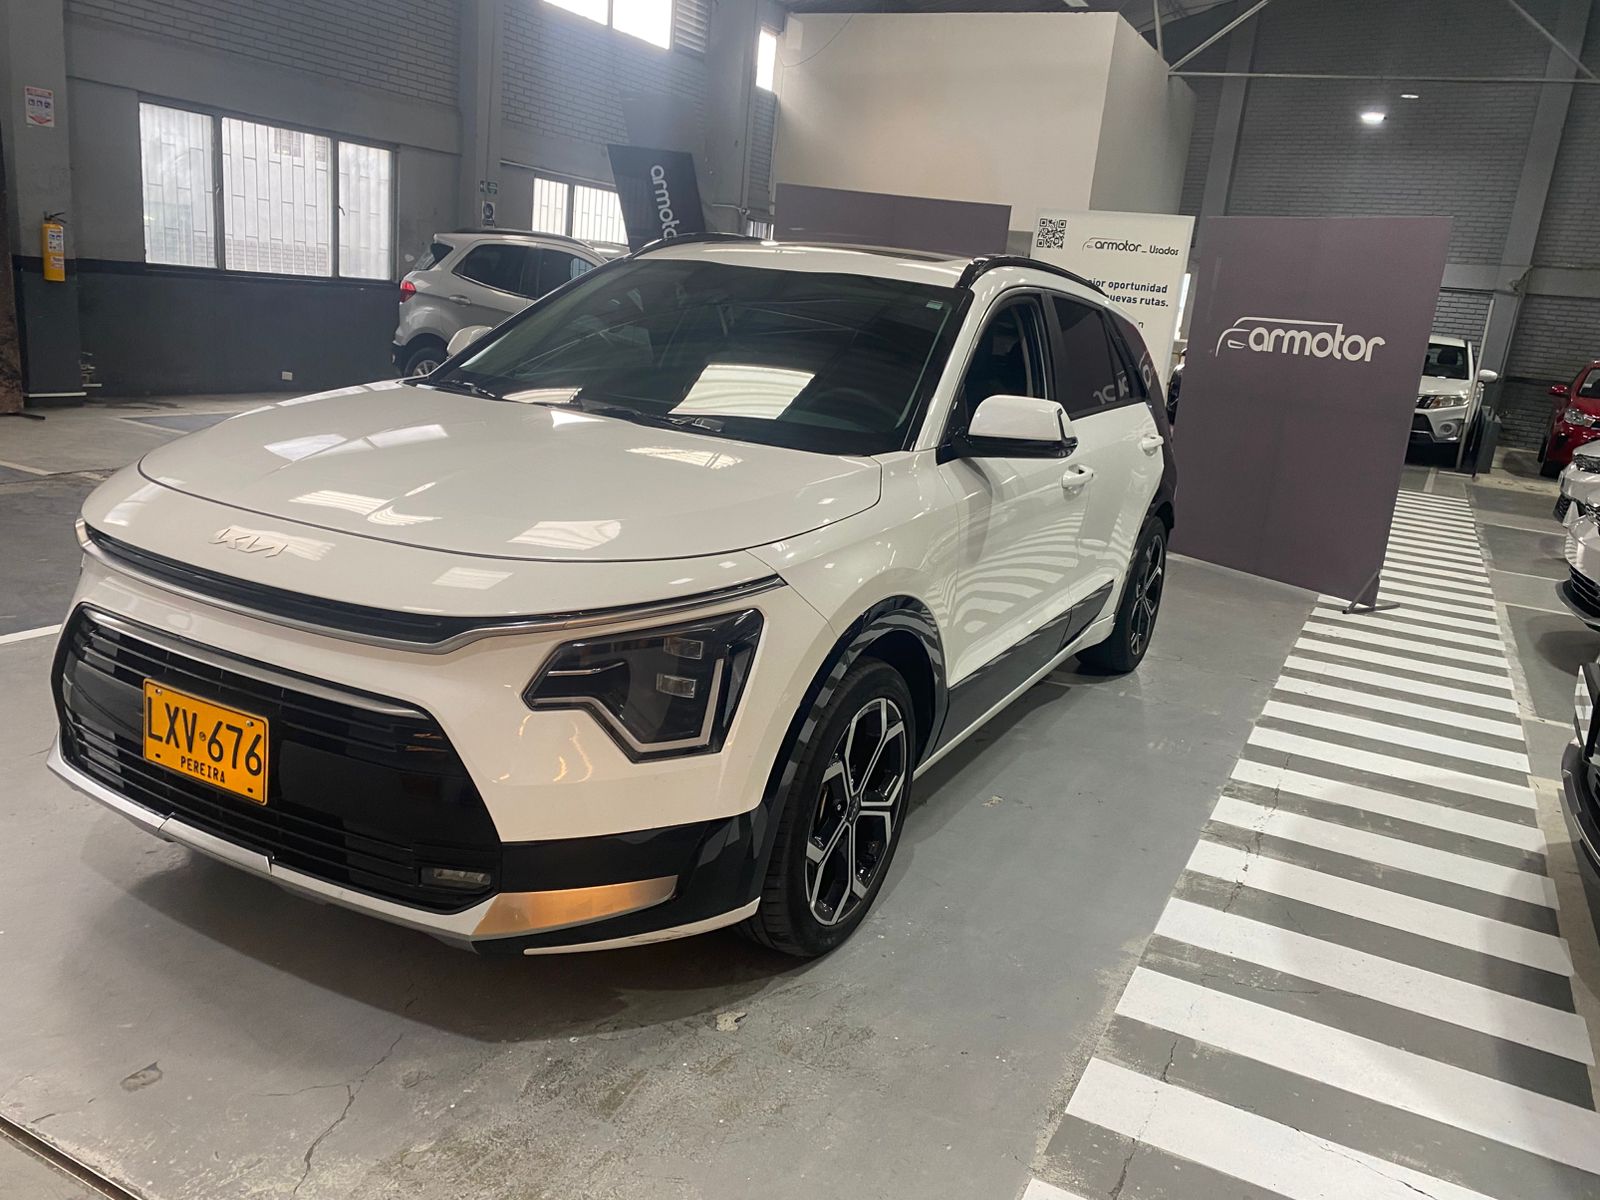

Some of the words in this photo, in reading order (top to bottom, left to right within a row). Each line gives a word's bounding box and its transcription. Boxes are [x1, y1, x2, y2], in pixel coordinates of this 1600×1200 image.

[650, 164, 680, 240] armoto
[1149, 245, 1179, 256] Usados
[1108, 280, 1168, 293] oportunidad
[1106, 294, 1137, 304] uevas
[1139, 296, 1169, 307] rutas.
[180, 755, 225, 783] PEREIRA
